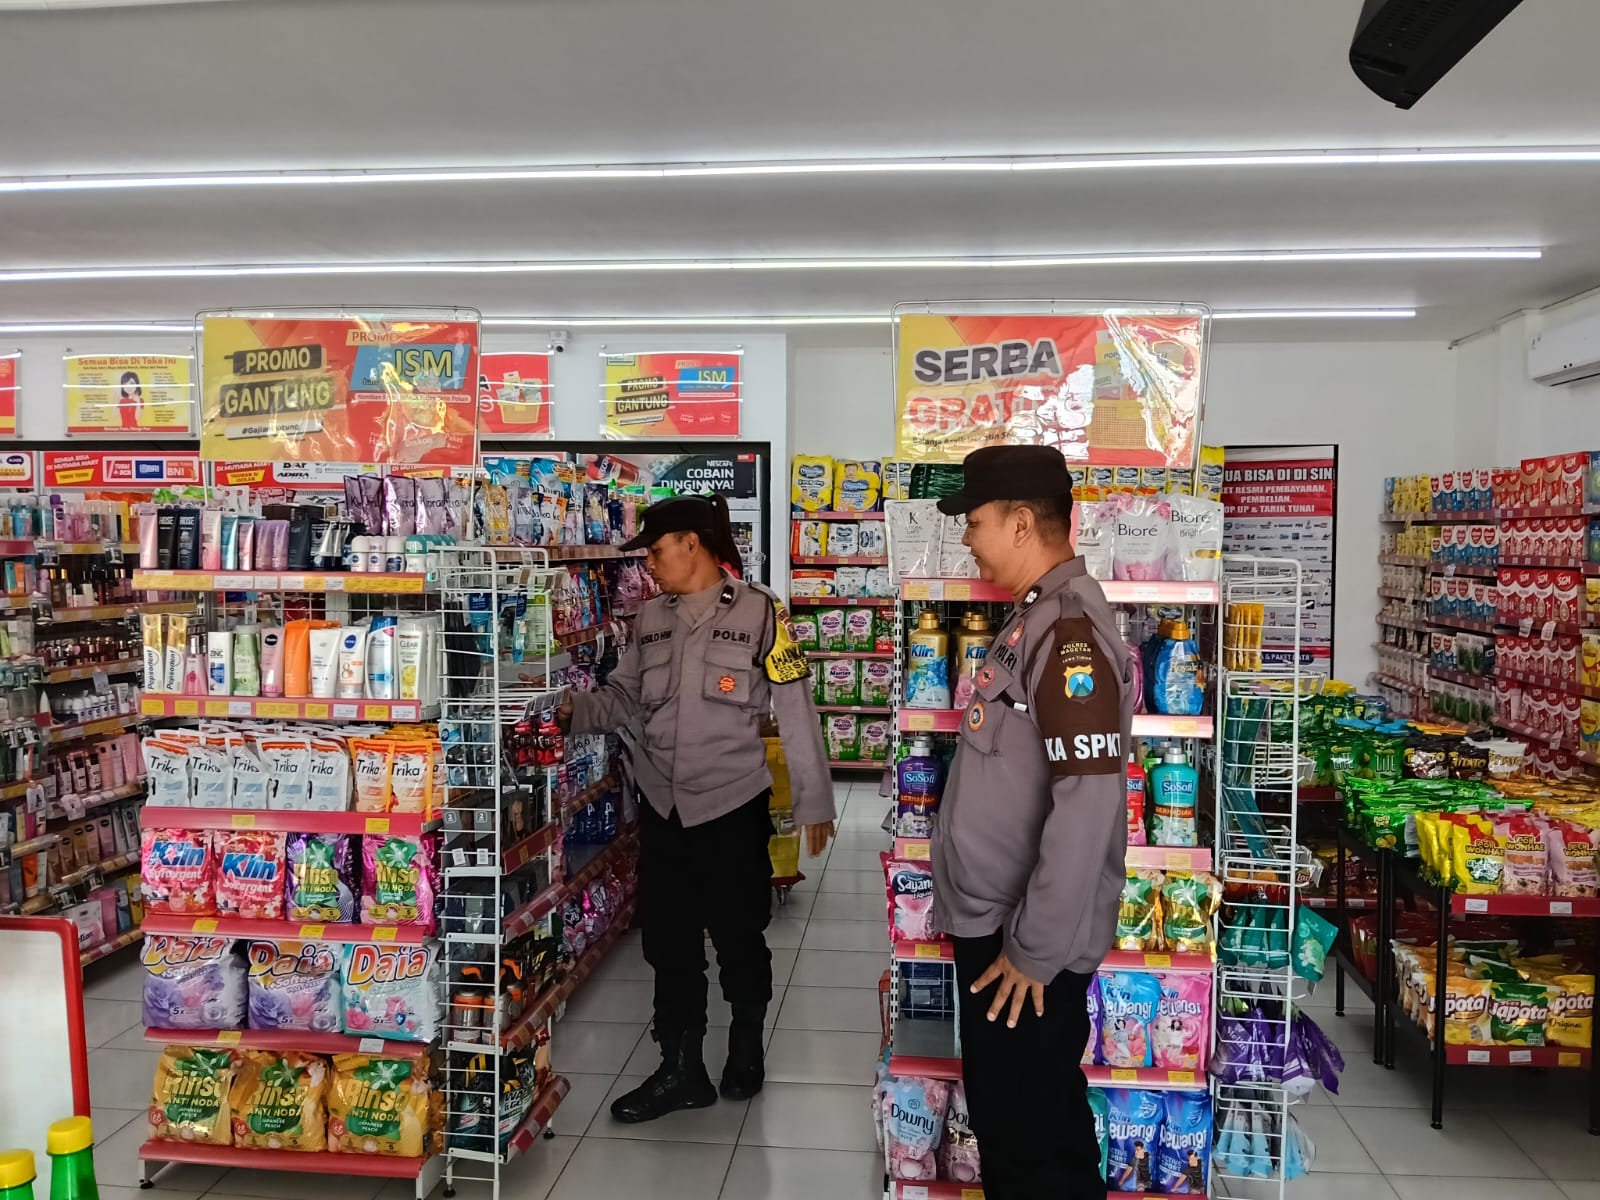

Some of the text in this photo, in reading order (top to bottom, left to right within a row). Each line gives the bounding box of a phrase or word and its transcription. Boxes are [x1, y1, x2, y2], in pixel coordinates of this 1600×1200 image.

[79, 356, 176, 366] Semua Bisa Di Toko Ini
[245, 347, 311, 373] PROMO
[914, 340, 1061, 383] SERBA
[626, 377, 659, 391] PROMO
[223, 379, 332, 415] GANTUNG
[617, 394, 668, 412] GANTUNG
[167, 467, 184, 476] BNI
[686, 468, 734, 479] COBAIN
[1244, 469, 1274, 481] BISA
[1277, 468, 1290, 480] DI
[1293, 468, 1307, 480] DI
[661, 479, 734, 490] DINGINNYA!
[1236, 486, 1263, 494] RESMI
[712, 629, 751, 644] POLRI
[911, 643, 935, 658] Klin
[1060, 647, 1091, 655] MAGETAN
[1062, 642, 1088, 650] POLRES
[147, 649, 155, 690] Pepsodent
[166, 649, 177, 690] Pepsodent
[1044, 736, 1068, 762] KA
[273, 759, 297, 773] Trika
[357, 759, 380, 775] Trika
[391, 762, 420, 776] Trika
[905, 773, 935, 784] SoSoft
[1163, 781, 1193, 792] SoSoft
[1466, 845, 1505, 856] WONHAE
[1506, 843, 1545, 851] WONHAE
[150, 841, 206, 868] Klin
[222, 851, 277, 882] Klin
[223, 881, 274, 894] Softergent
[392, 884, 416, 892] NODA
[142, 935, 226, 967] Daia
[248, 940, 335, 977] Daia
[347, 944, 431, 986] Daia
[1105, 986, 1131, 1000] Klin
[172, 1007, 184, 1015] 5x
[1490, 1001, 1549, 1023] Japota
[373, 1016, 384, 1024] 5x
[345, 1079, 409, 1112] Rinso
[192, 1099, 219, 1107] NODA
[248, 1108, 301, 1117] ANTI NODA
[371, 1112, 400, 1122] NODA
[891, 1103, 935, 1136] Downy
[1159, 1124, 1207, 1150] Pewangi
[1161, 1154, 1182, 1165] ACTIVE
[1161, 1160, 1182, 1172] SPORT
